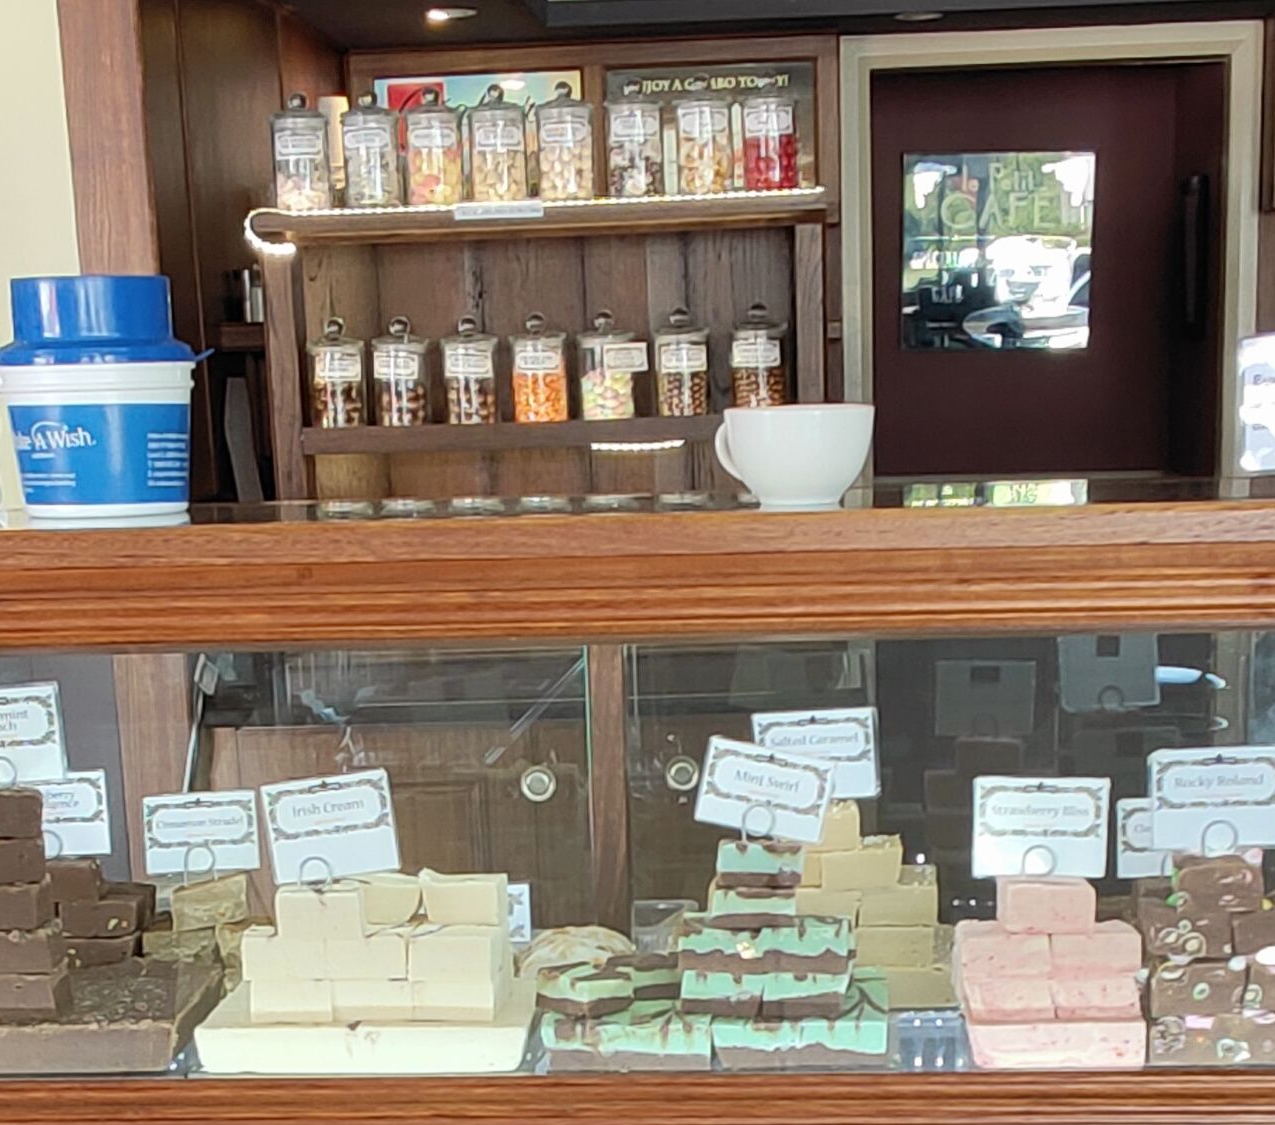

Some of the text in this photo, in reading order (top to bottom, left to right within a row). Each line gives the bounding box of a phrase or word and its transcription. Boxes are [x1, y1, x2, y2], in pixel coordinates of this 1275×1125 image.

[684, 77, 736, 91] CMBO
[740, 74, 789, 88] TOY!
[770, 731, 859, 747] Salted Caramel
[734, 768, 800, 793] Mint Swirl
[1174, 775, 1214, 790] Rocky
[292, 799, 365, 818] Irish Cream
[991, 804, 1090, 819] Strawberry Bliss
[208, 815, 244, 827] Strudel
